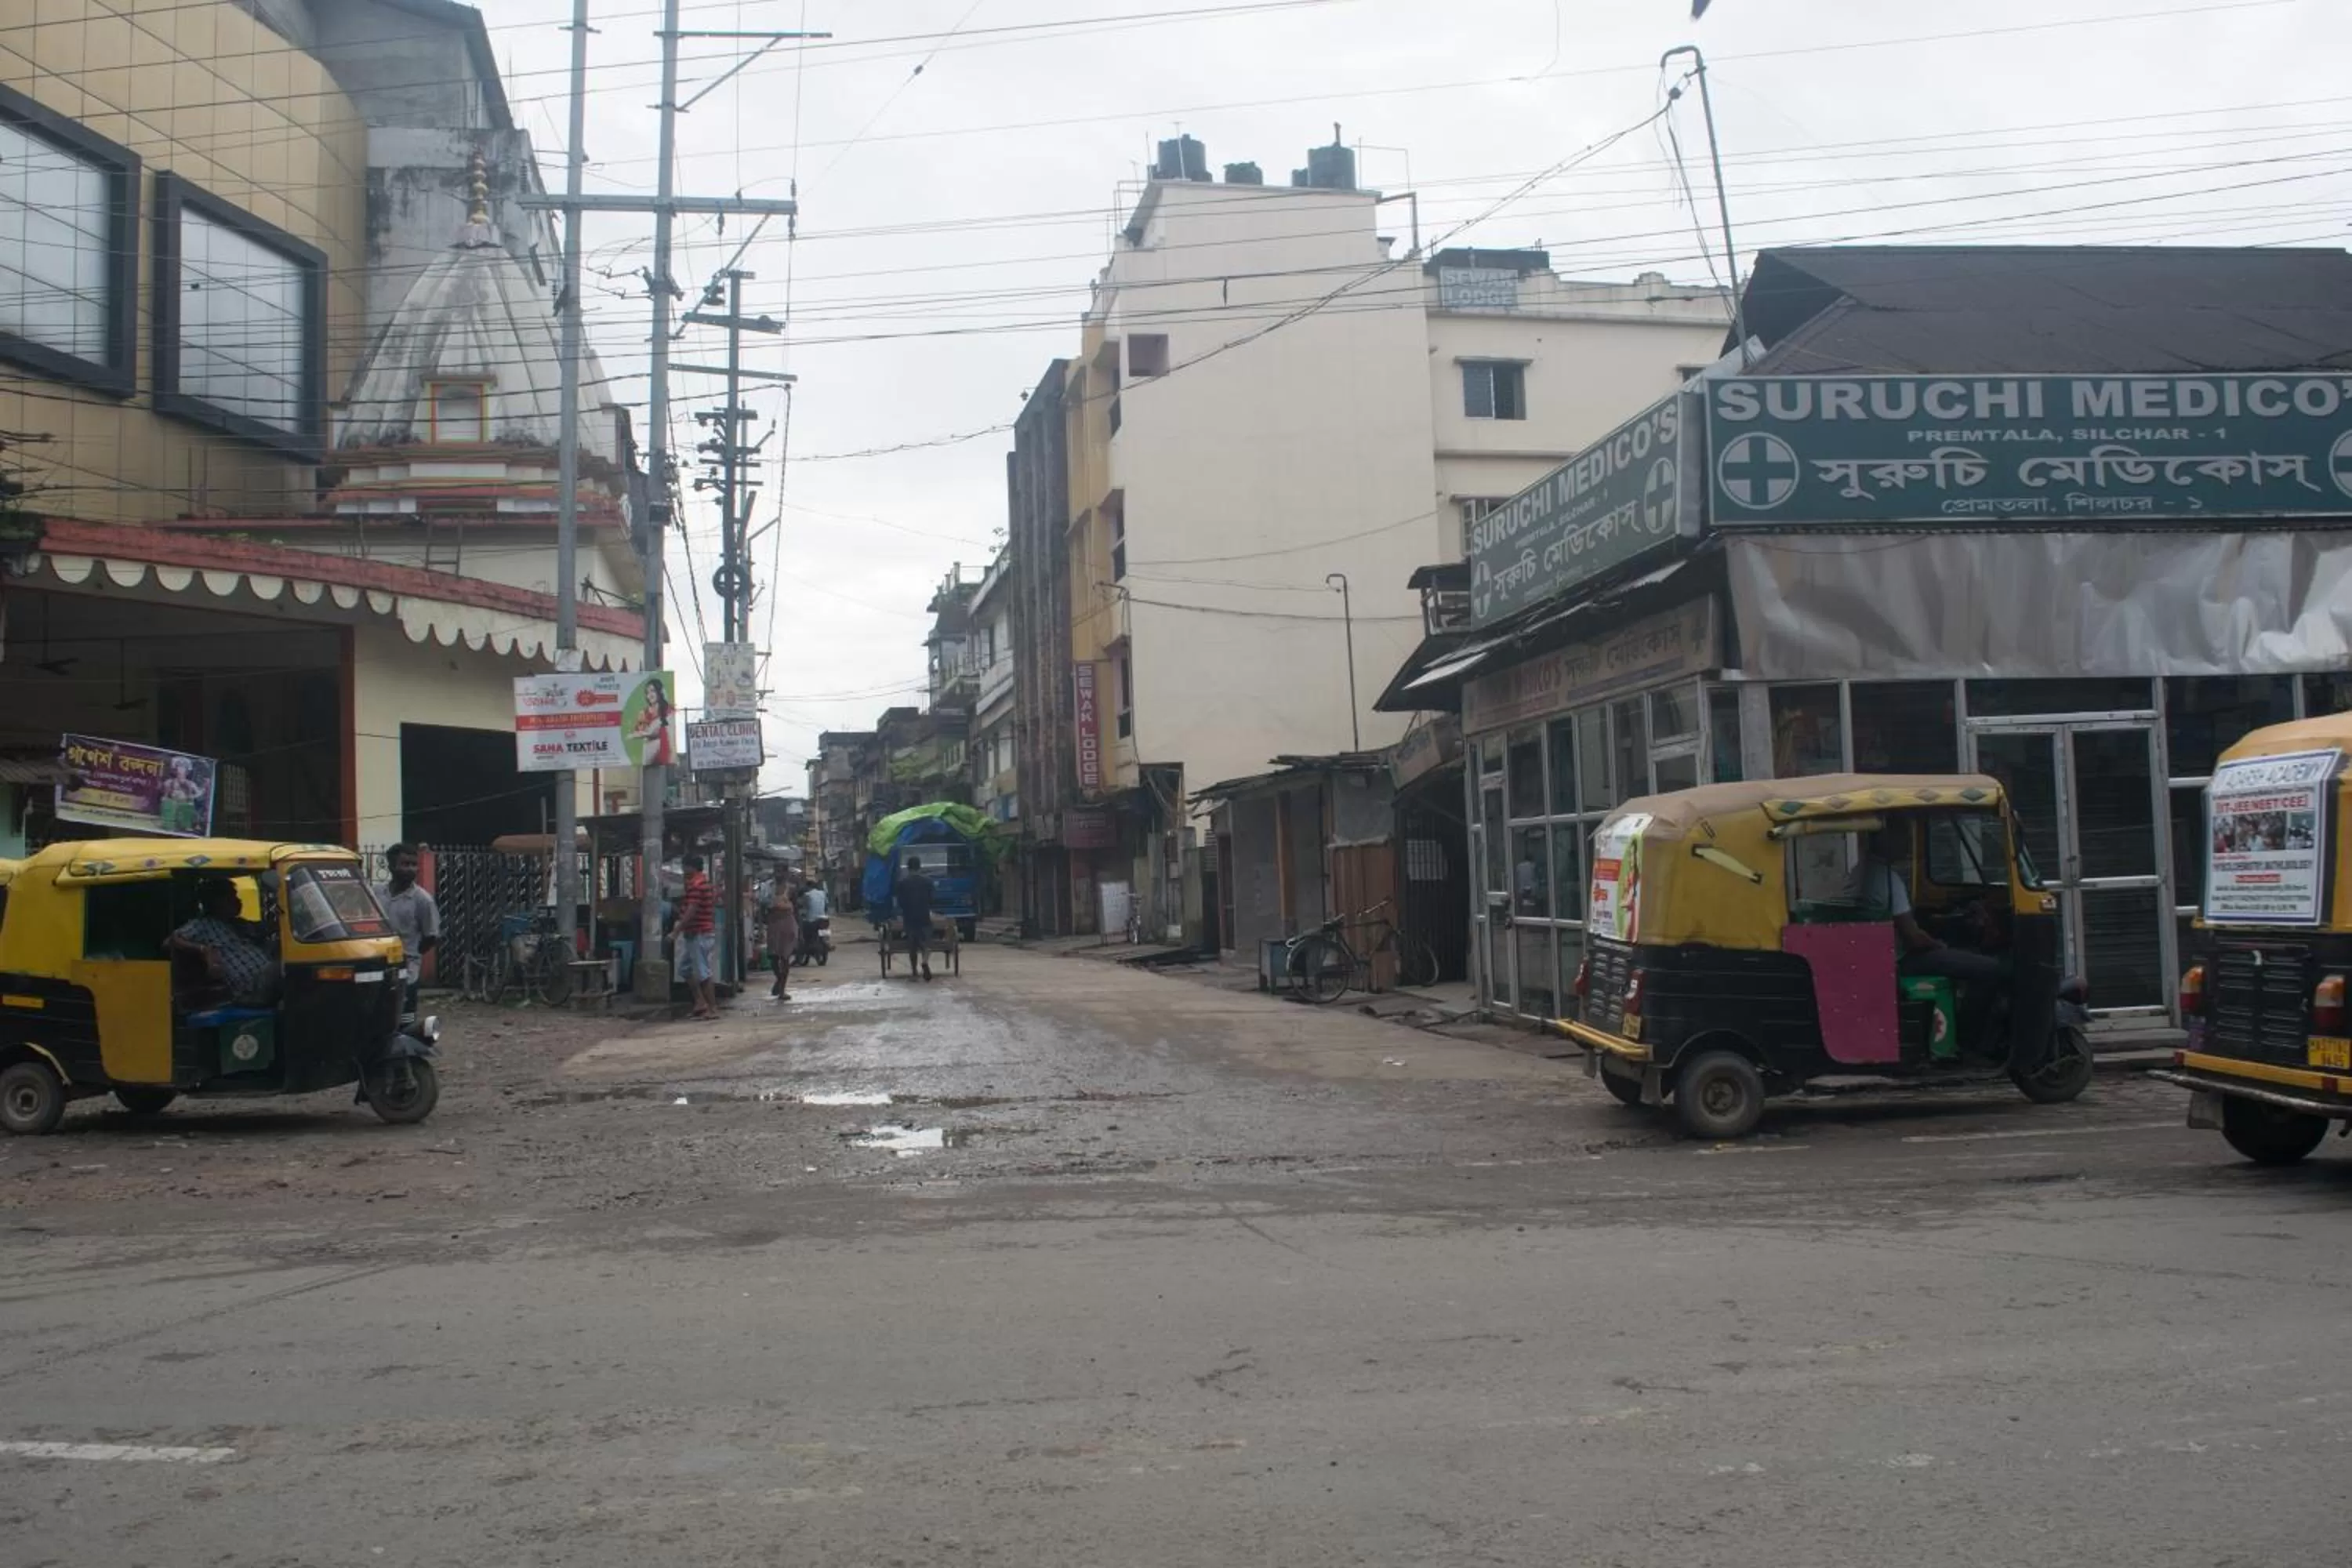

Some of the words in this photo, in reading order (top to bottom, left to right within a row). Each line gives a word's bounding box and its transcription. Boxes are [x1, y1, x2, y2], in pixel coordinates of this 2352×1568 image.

[1444, 270, 1515, 289] SEWAK
[1446, 288, 1514, 305] LODGE
[1716, 380, 2045, 422] SURUCHI
[1907, 429, 2064, 444] PREMTALA,
[2072, 427, 2190, 441] SILCHAR
[2215, 427, 2227, 440] 1
[1472, 481, 1552, 556] SURUCHI
[1557, 403, 1678, 506] MEDICO'S
[1809, 446, 1991, 502] সুরুচি
[1077, 665, 1094, 722] SEWAK
[688, 724, 726, 739] DENTAL
[727, 722, 757, 736] CLINIC
[533, 742, 564, 754] SAHA
[565, 739, 609, 753] TEXTILE
[1081, 727, 1099, 785] LODGE
